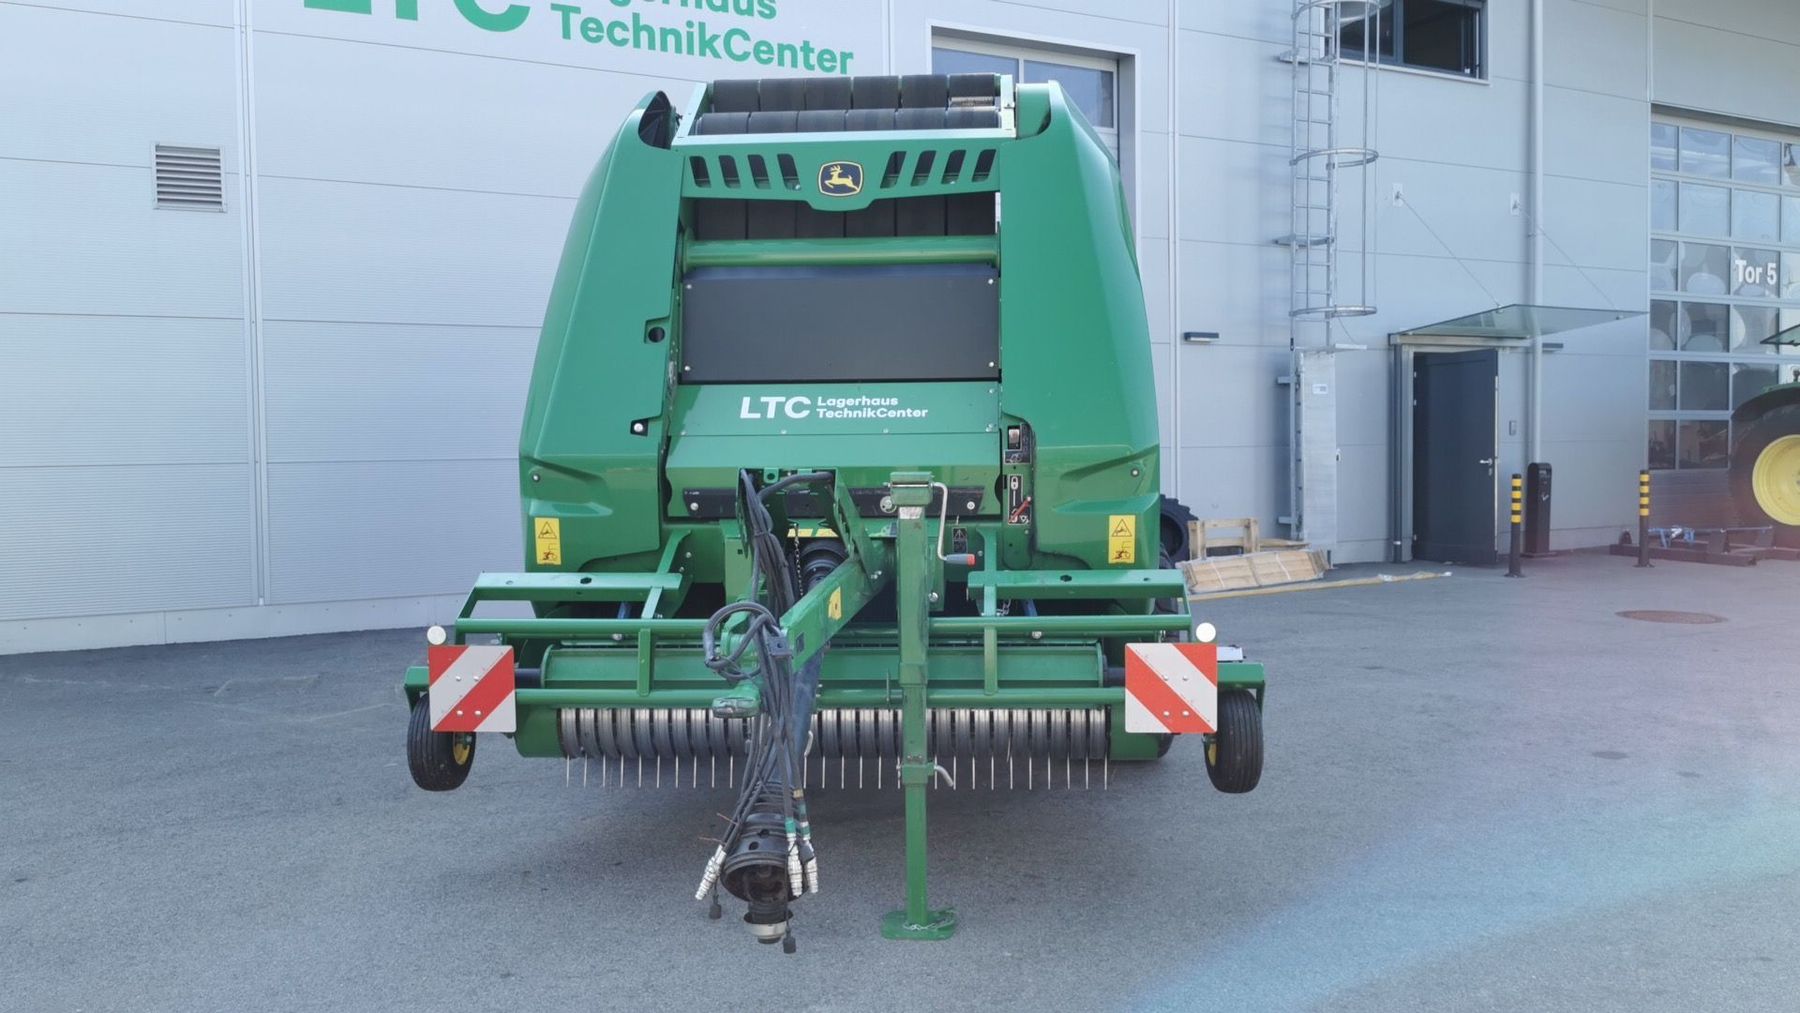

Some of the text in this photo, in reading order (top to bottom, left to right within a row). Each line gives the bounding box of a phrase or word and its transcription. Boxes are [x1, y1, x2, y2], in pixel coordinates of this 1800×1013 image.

[550, 3, 854, 75] TechnikCenter
[1734, 259, 1778, 285] Tor 5
[740, 396, 811, 419] LTC
[816, 408, 928, 419] TechnikCenter
[817, 396, 899, 408] Lagerhaus
